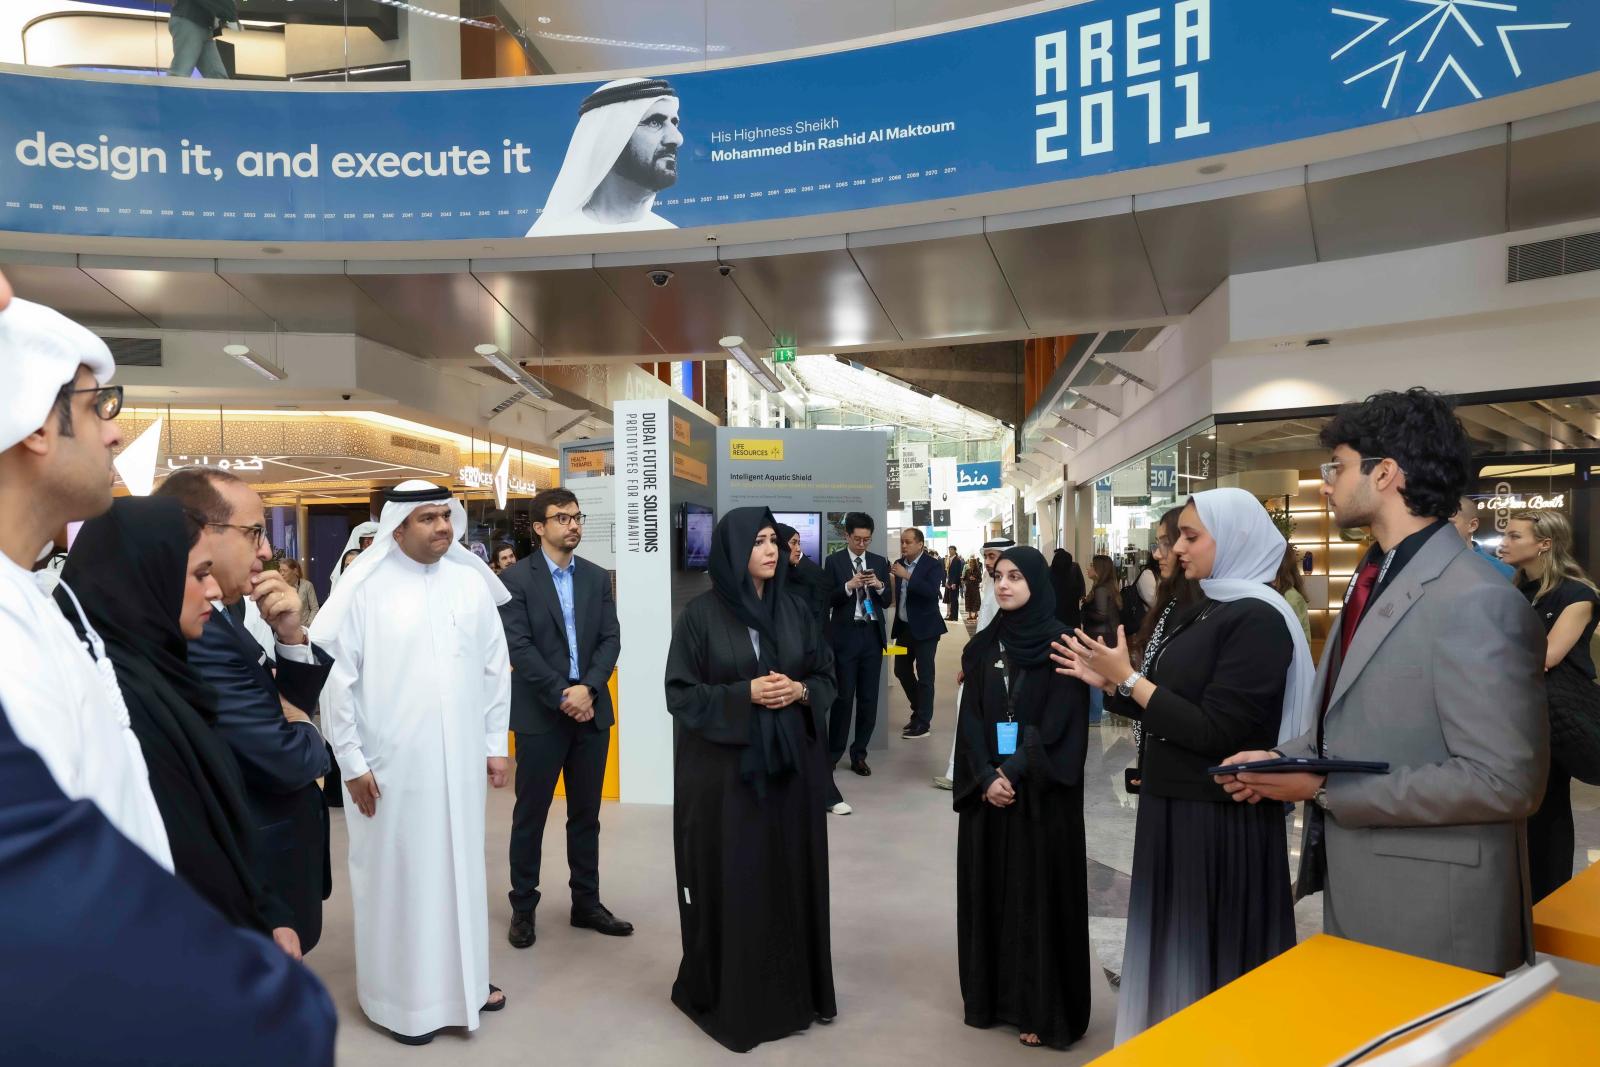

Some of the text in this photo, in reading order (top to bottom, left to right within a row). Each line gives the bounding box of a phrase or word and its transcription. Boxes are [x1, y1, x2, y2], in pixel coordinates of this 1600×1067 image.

[1035, 0, 1210, 96] AREA
[711, 116, 839, 143] His Highness Sheikh
[711, 121, 955, 162] Mohammed bin Rashid Al Maktoum
[1035, 71, 1210, 164] 2071
[15, 131, 531, 181] design it, and execute it
[460, 466, 493, 485] SERVICES
[626, 413, 640, 553] PROTOTYPES FOR HUMANITY
[643, 412, 658, 553] DUBAI FUTURE SOLUTIONS
[730, 473, 812, 482] Intelligent Aquatic Shield
